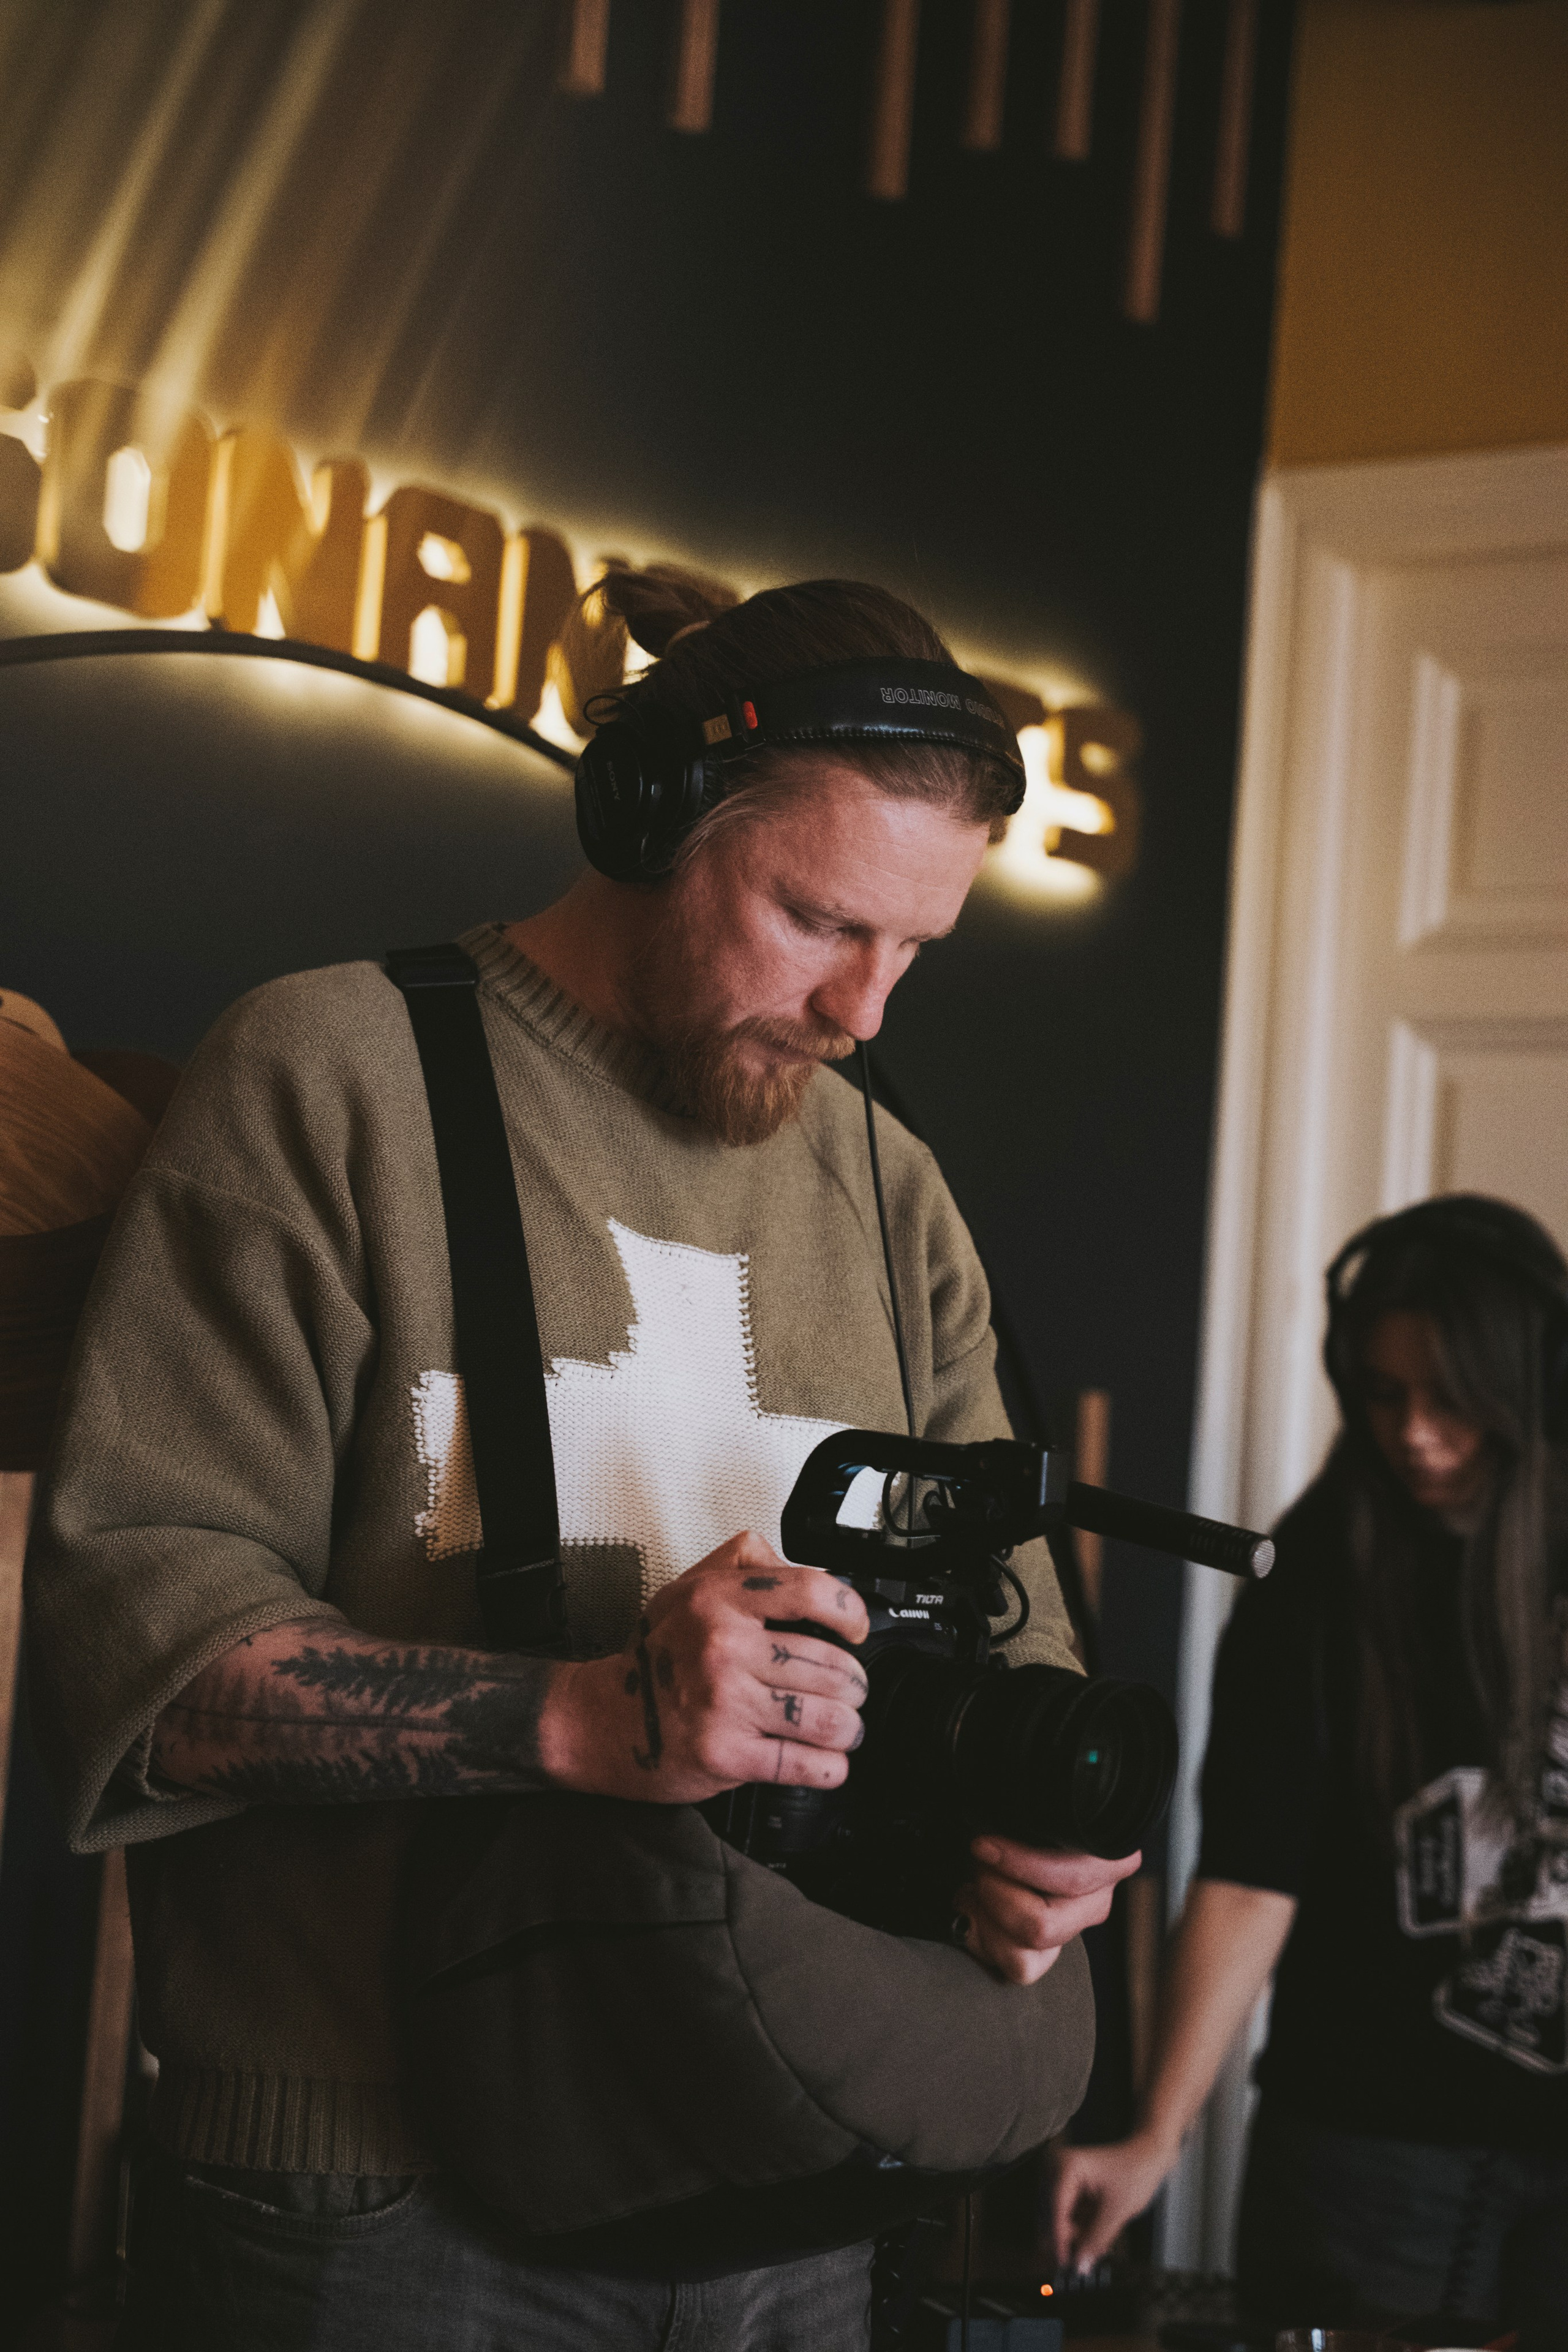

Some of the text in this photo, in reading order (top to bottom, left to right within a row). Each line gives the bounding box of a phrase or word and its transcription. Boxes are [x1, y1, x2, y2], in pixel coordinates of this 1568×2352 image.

[880, 687, 961, 710] MONITOR
[606, 760, 620, 800] SONY
[916, 1594, 944, 1605] TILTA
